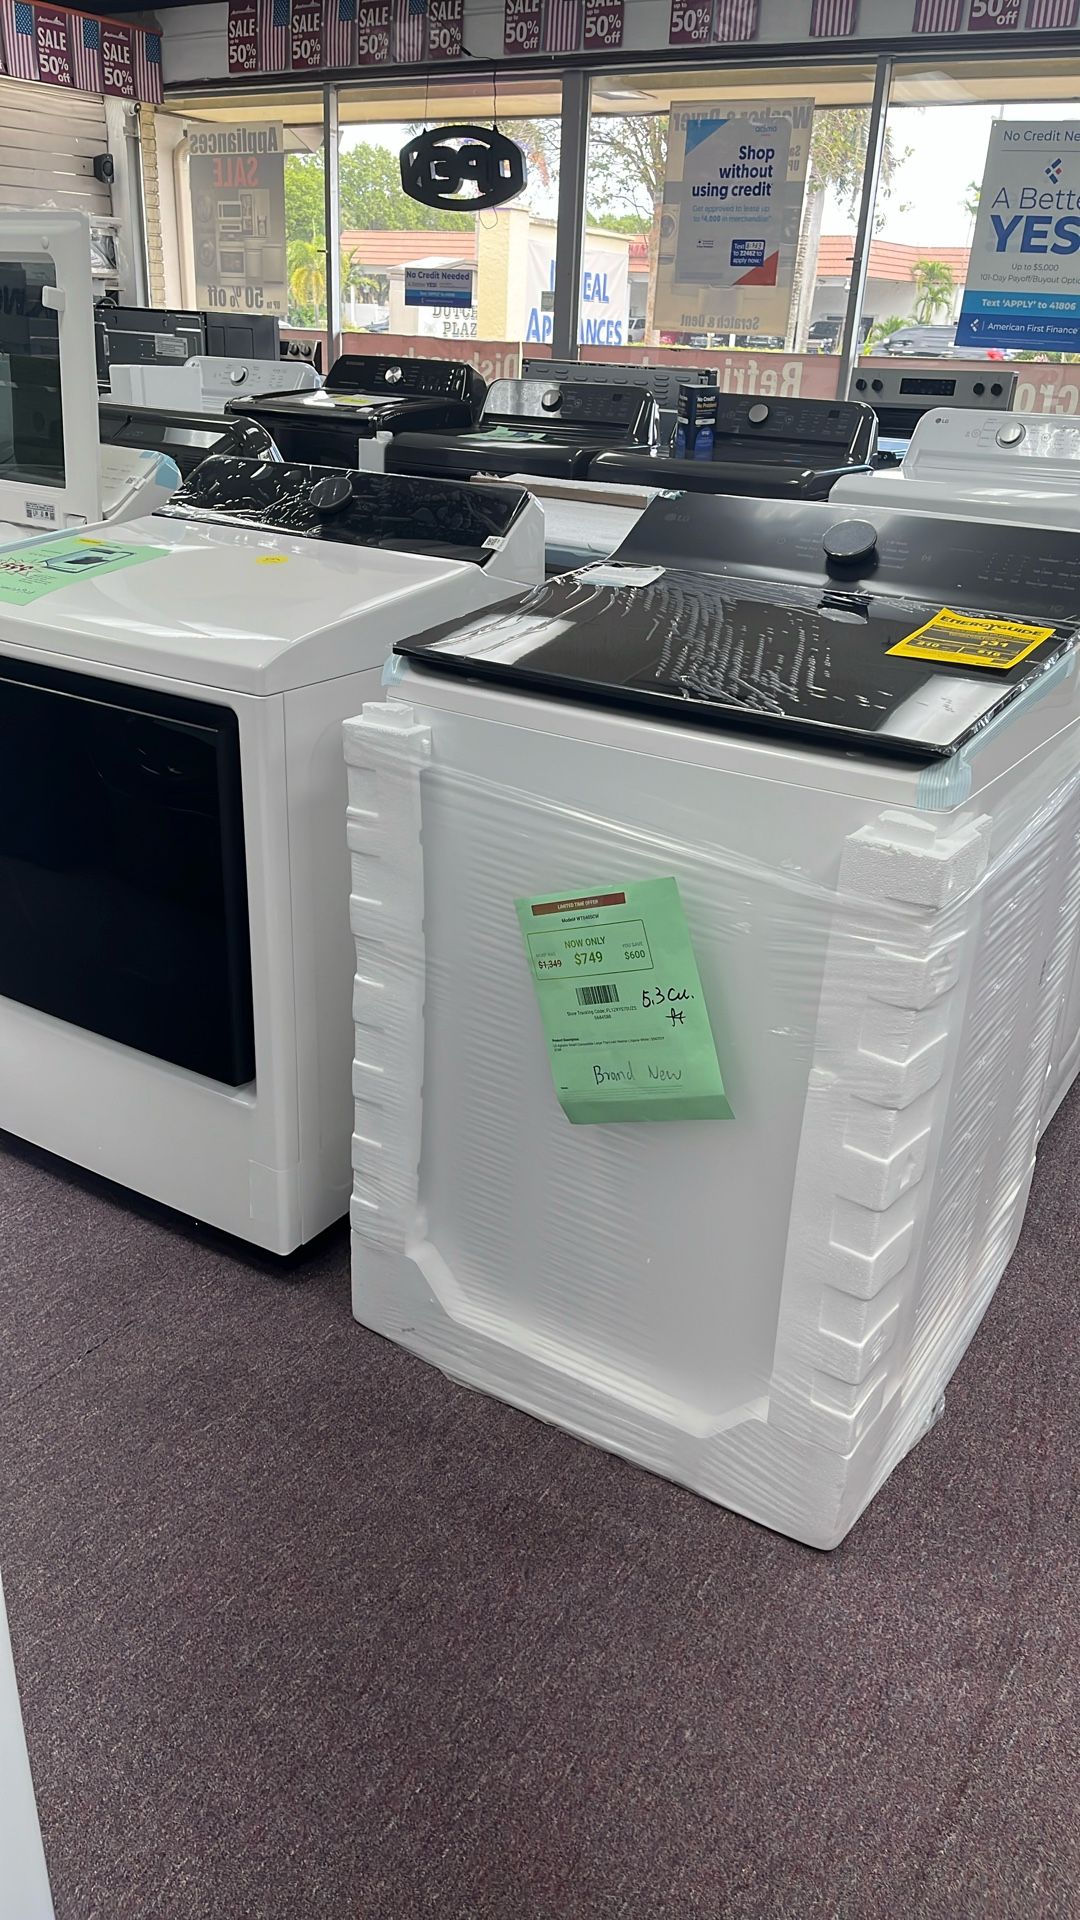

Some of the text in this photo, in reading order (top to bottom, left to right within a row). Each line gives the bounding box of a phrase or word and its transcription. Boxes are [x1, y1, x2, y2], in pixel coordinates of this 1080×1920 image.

[430, 0, 461, 21] SALE
[506, 0, 539, 14] SALE
[292, 13, 320, 33] SALE
[360, 7, 388, 27] SALE
[672, 8, 710, 32] 50%
[997, 11, 1017, 25] off
[229, 19, 255, 38] SALE
[506, 21, 539, 43] 50%
[585, 15, 621, 38] 50%
[692, 26, 708, 40] off
[38, 27, 66, 50] SALE
[360, 33, 388, 54] 50%
[430, 28, 461, 49] 50%
[524, 38, 538, 49] off
[605, 30, 620, 44] off
[103, 42, 130, 64] SALE
[230, 44, 256, 63] 50%
[293, 39, 320, 59] 50%
[375, 48, 387, 60] off
[447, 44, 460, 55] off
[39, 54, 68, 74] 50%
[244, 58, 256, 69] off
[308, 54, 320, 65] off
[58, 72, 70, 83] off
[104, 68, 133, 86] 50%
[122, 85, 133, 95] off
[1004, 130, 1020, 141] No
[1024, 130, 1061, 141] Credit
[739, 145, 774, 163] Shop
[720, 164, 773, 178] without
[692, 182, 771, 200] using credit
[991, 187, 1010, 208] A
[550, 260, 609, 304] IEAL
[980, 274, 1006, 282] 101-Day
[982, 299, 1000, 307] Text
[1038, 301, 1047, 309] to
[1049, 301, 1076, 310] 41806
[526, 308, 622, 345] APNCES
[988, 323, 1025, 331] American
[1046, 325, 1078, 334] Finance
[565, 937, 605, 949] NOW ONLY
[538, 950, 645, 969] $1,349 $749 $600
[593, 1060, 682, 1085] Brand New
